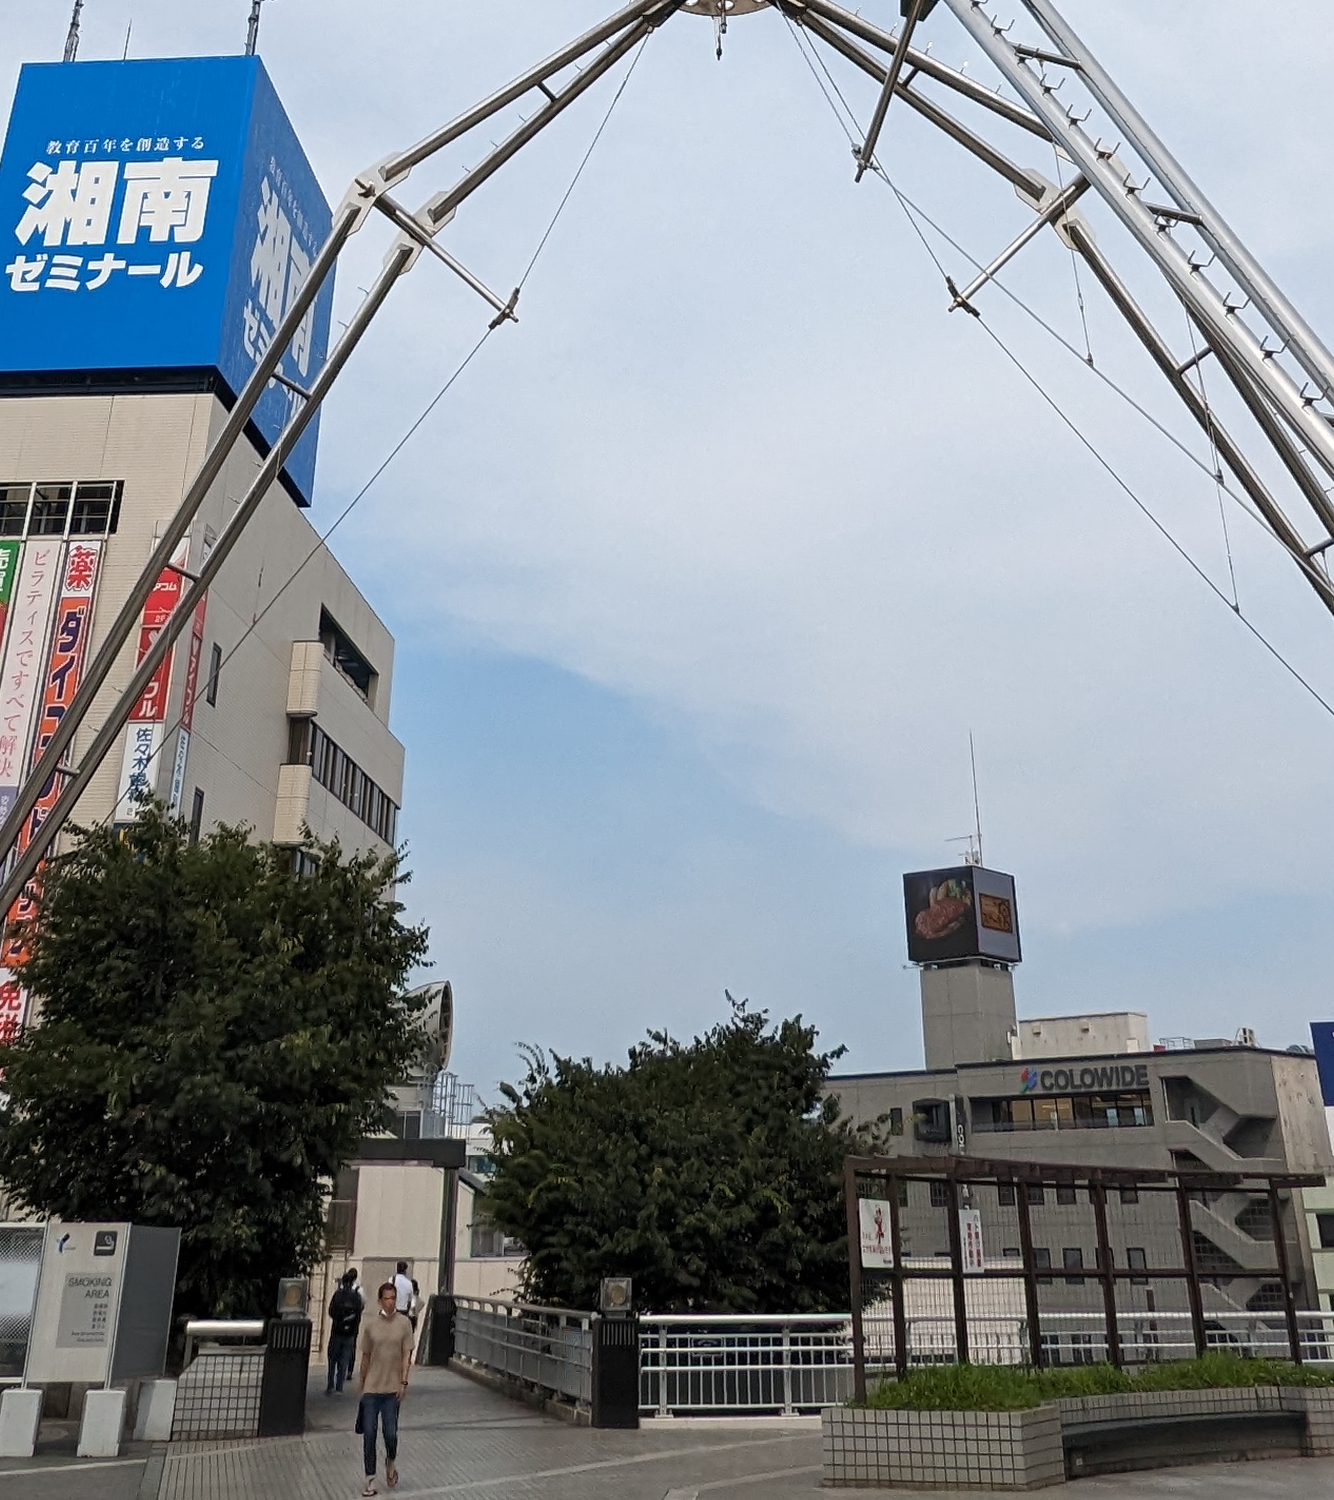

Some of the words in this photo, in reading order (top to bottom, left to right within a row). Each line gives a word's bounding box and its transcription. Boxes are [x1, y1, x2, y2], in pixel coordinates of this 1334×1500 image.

[46, 136, 205, 154] 教育百年を創造する
[15, 157, 219, 246] 湘南
[5, 252, 204, 291] ゼミナール
[66, 545, 99, 590] 薬
[153, 581, 178, 591] アコム
[1040, 1064, 1149, 1091] COLOWIDE
[68, 1277, 113, 1287] SMOKING
[85, 1289, 110, 1298] AREA
